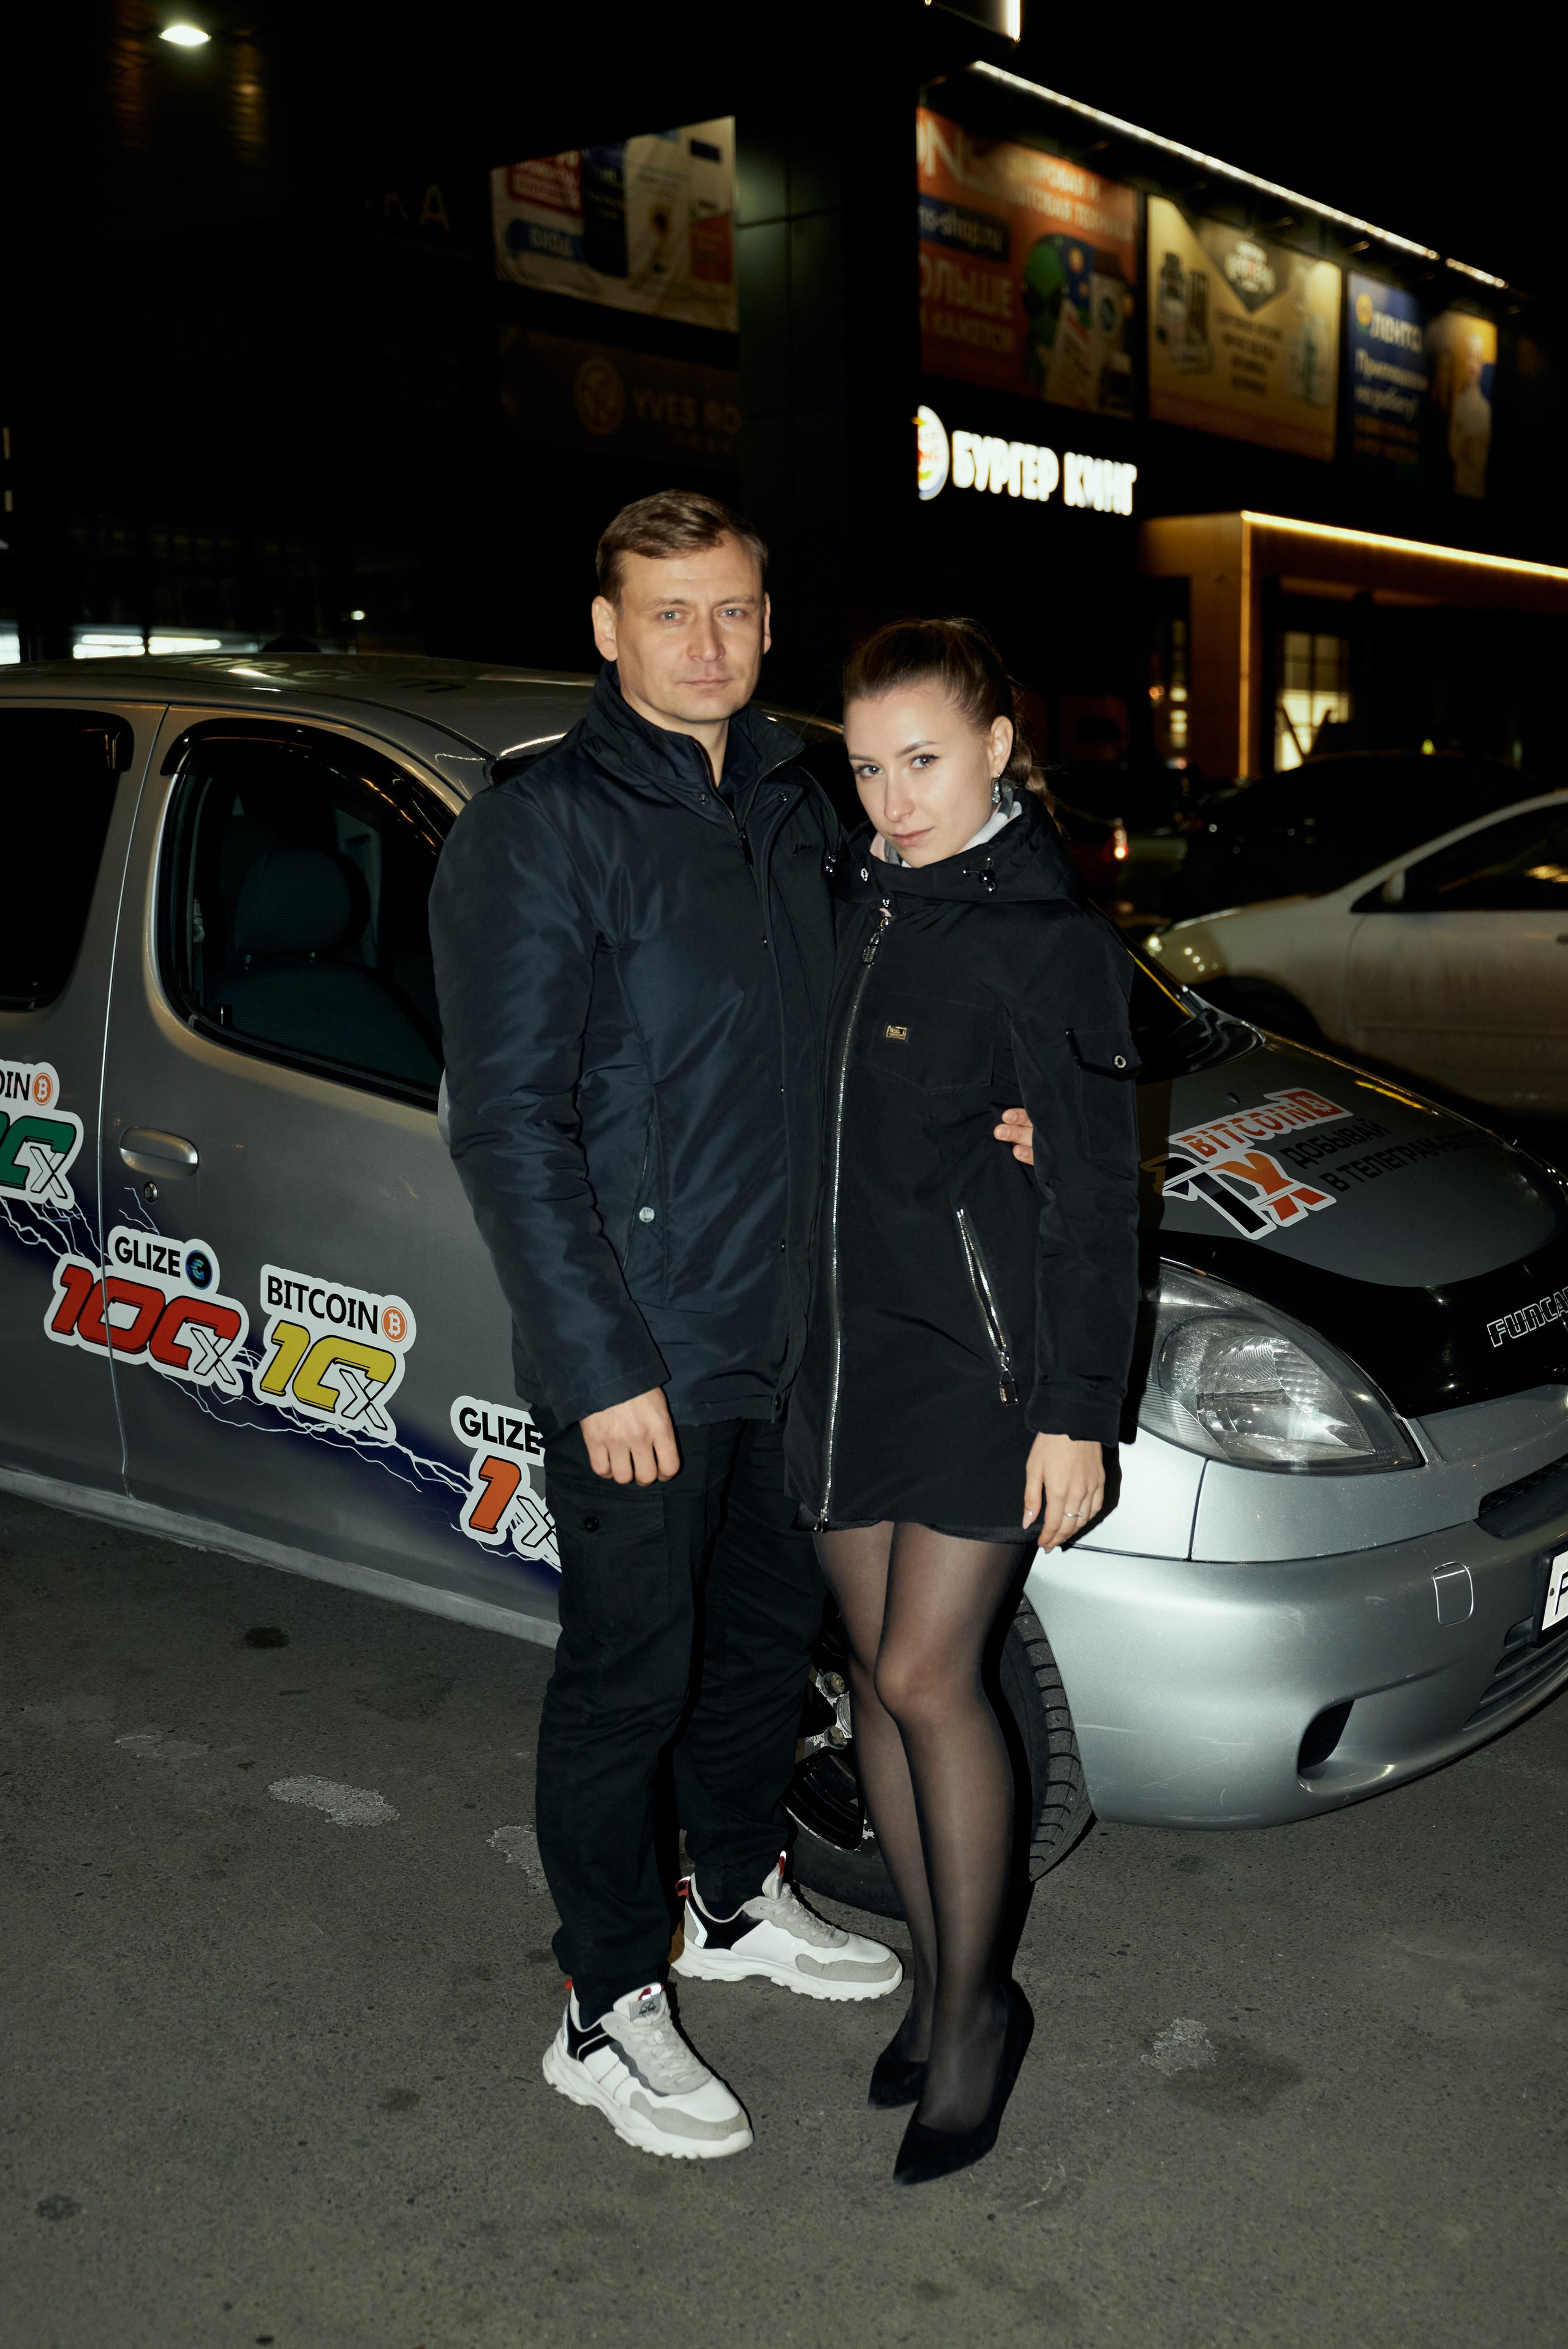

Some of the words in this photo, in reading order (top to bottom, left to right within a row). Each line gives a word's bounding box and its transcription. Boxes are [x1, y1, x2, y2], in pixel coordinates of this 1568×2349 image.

[952, 430, 1059, 502] БУРГЕР
[1064, 451, 1137, 516] КИНГ
[1173, 1098, 1317, 1158] BITCOIN
[1279, 1118, 1393, 1169] ДОБЫВАЙ
[1318, 1172, 1351, 1193] В
[115, 1236, 181, 1278] GLIZE
[267, 1275, 379, 1335] BITCOIN
[459, 1407, 541, 1455] GLIZE
